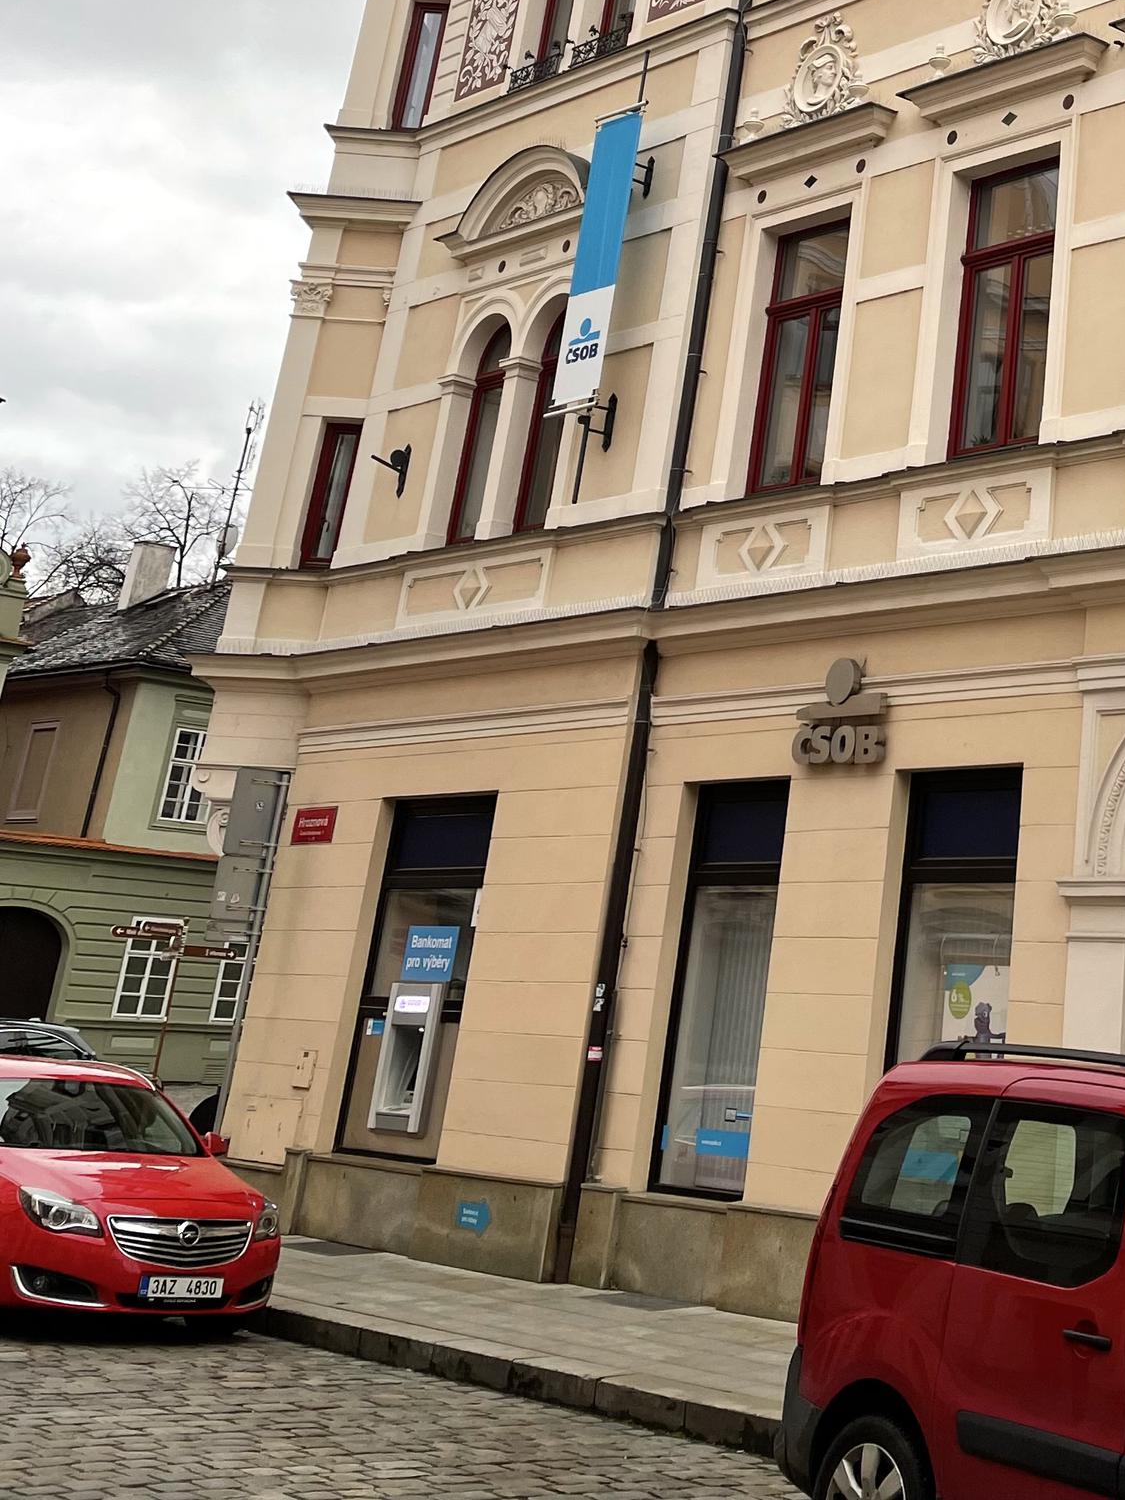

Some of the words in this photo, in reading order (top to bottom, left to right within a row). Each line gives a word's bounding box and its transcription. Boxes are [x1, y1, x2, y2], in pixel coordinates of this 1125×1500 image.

[791, 722, 887, 765] ČSOB
[411, 935, 453, 949] Bankomat
[405, 957, 421, 971] pro
[422, 954, 451, 972] výběry
[151, 1279, 178, 1295] 3AZ
[186, 1280, 217, 1296] 4830
